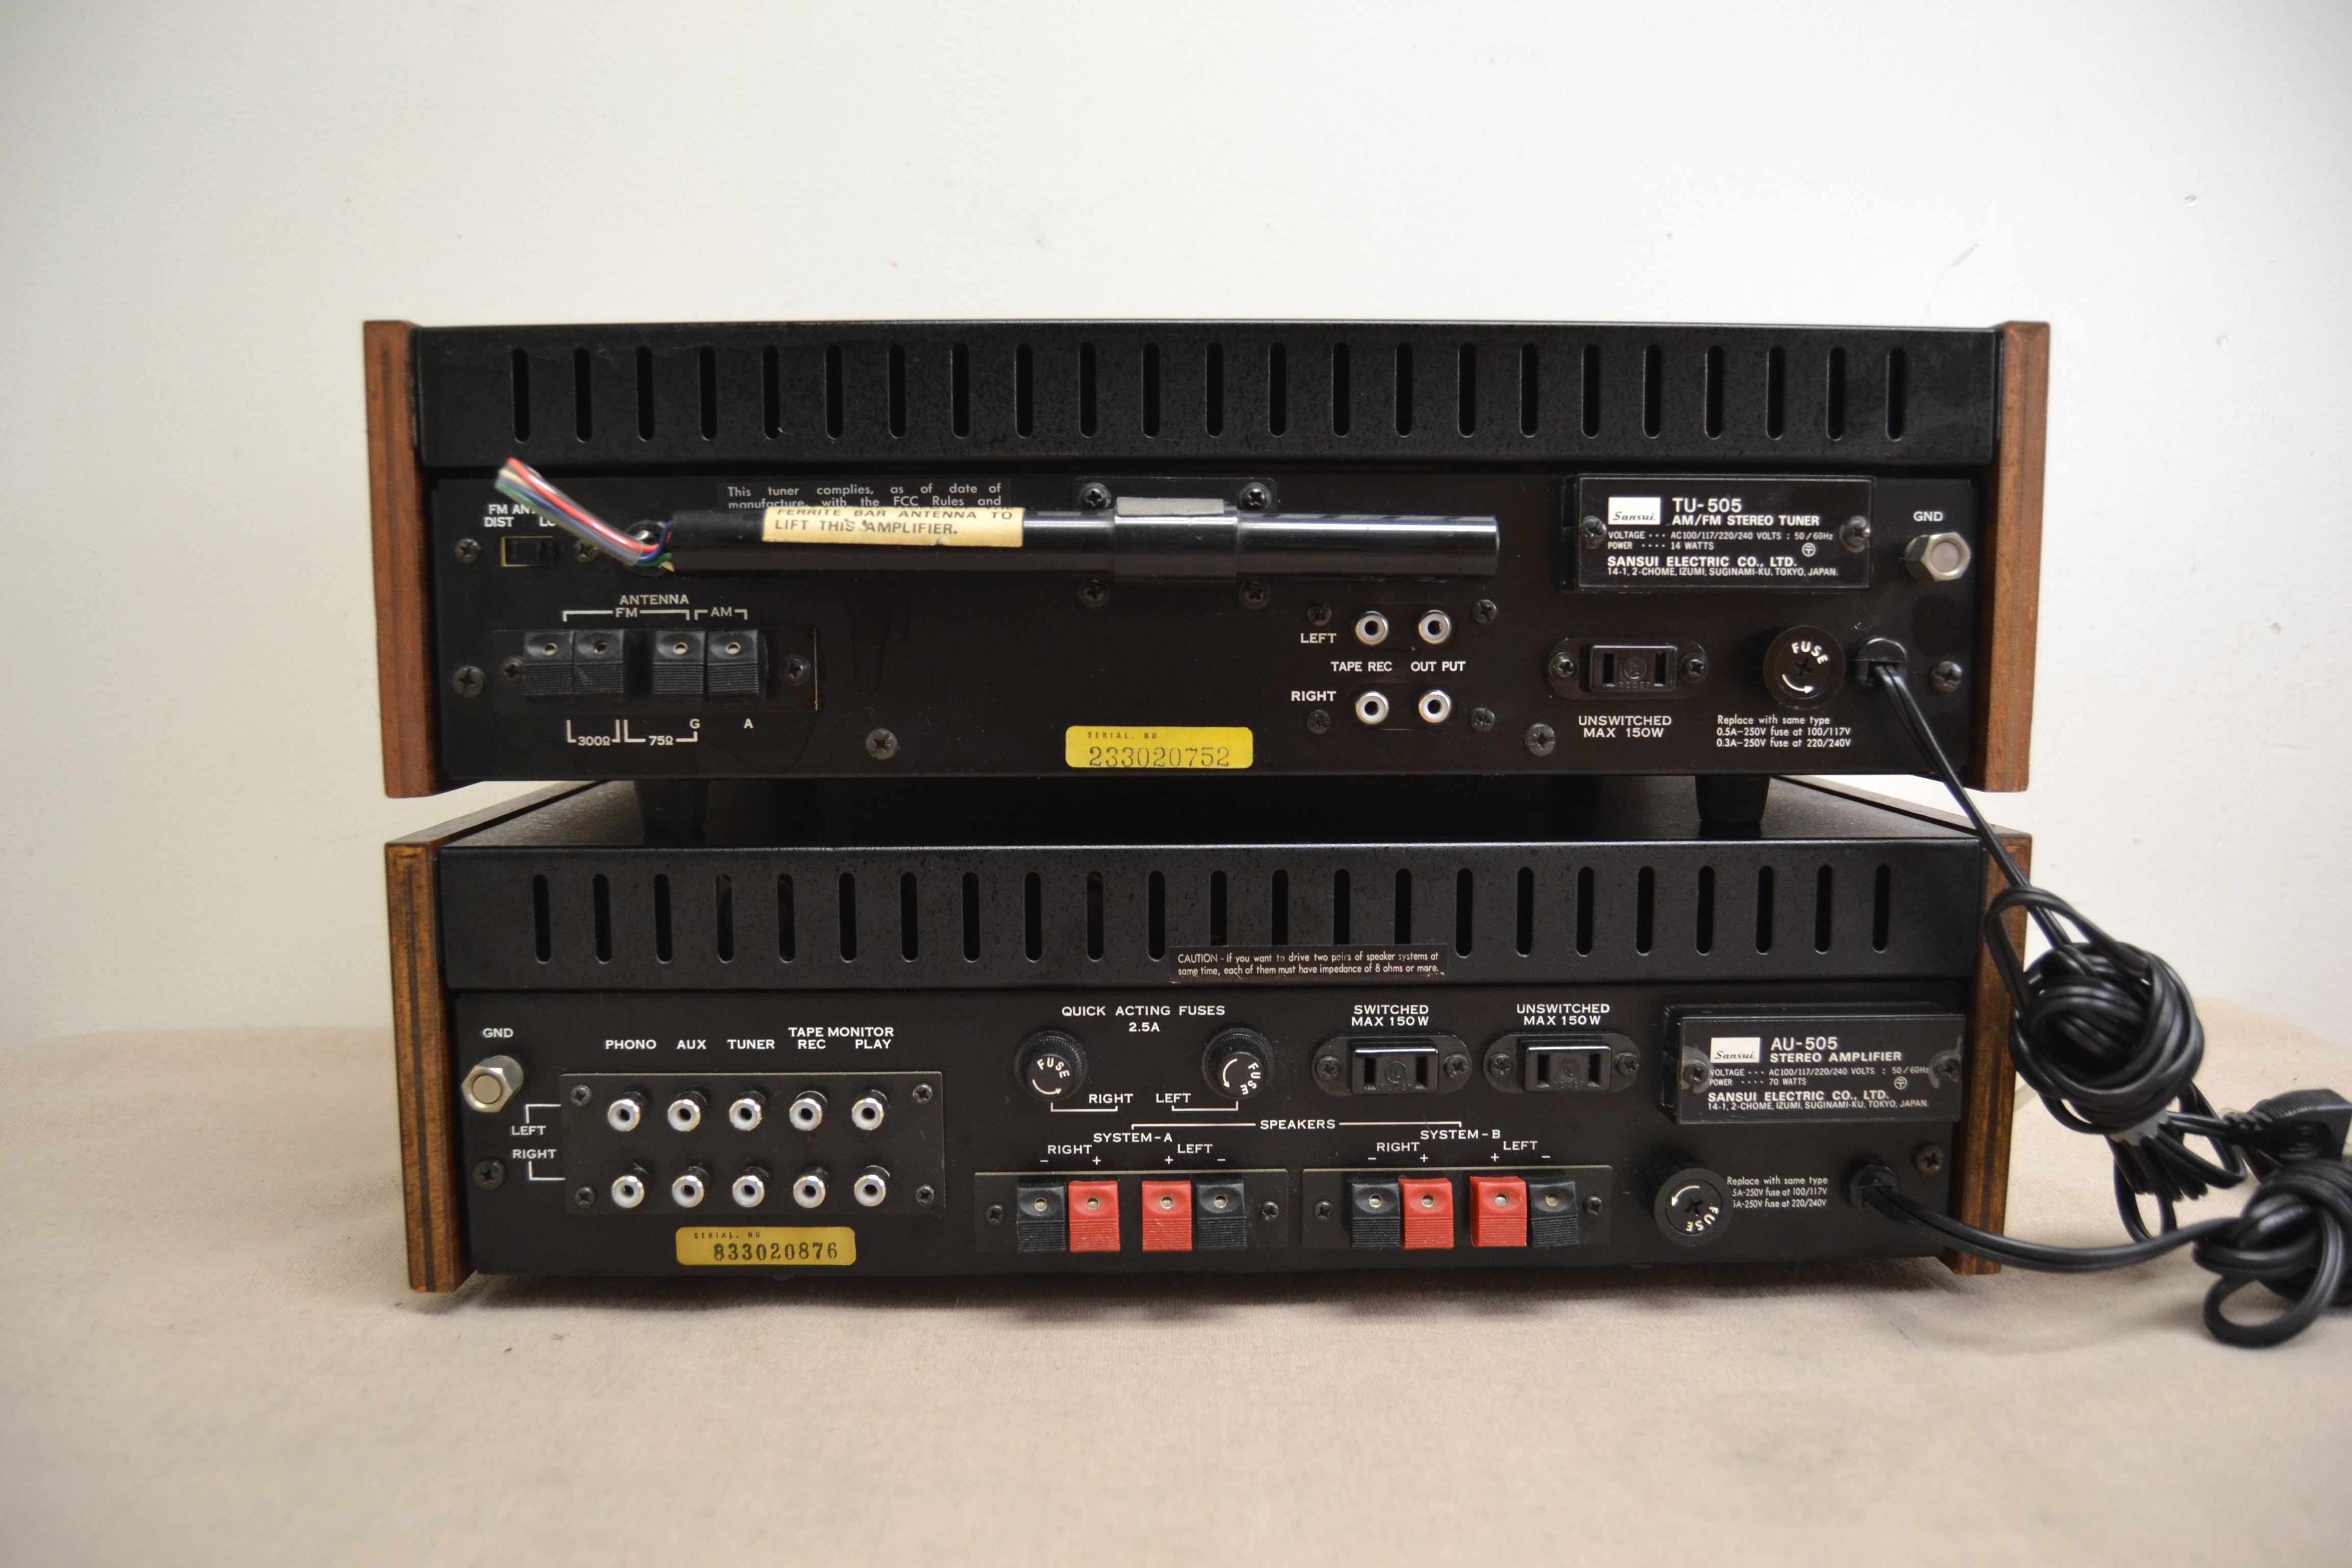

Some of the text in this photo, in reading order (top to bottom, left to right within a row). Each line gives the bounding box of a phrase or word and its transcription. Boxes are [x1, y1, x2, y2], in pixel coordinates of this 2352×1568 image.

[727, 486, 751, 497] This
[768, 486, 799, 496] tuner
[817, 484, 874, 496] complies,
[920, 482, 933, 494] of
[949, 483, 978, 494] date
[988, 482, 1001, 494] of
[821, 496, 1001, 507] with the FCC Rules and
[1672, 497, 1742, 513] TU-505
[488, 504, 508, 515] FM
[898, 510, 976, 519] ANTENNA
[483, 516, 514, 527] DIST
[1672, 513, 1820, 526] AM/FM STEREO TUNER
[1913, 511, 1944, 522] GND
[775, 519, 958, 535] LIFT THIS AMPLIFIER.
[1608, 530, 1782, 540] VOLTAGE VOLTS
[1607, 541, 1714, 550] POWER 14 WATTS
[1607, 555, 1659, 567] SANSUI
[1665, 556, 1729, 569] ELECTRIC
[1769, 556, 1797, 567] LTD.
[1679, 567, 1707, 577] IZUMI,
[1775, 567, 1807, 577] TOKYO,
[619, 594, 690, 605] ANTENNA
[616, 607, 732, 618] FM AM
[1300, 632, 1337, 644] LEFT
[1791, 641, 1829, 664] FUSE
[1330, 661, 1392, 672] TAPE REC
[1410, 660, 1466, 672] OUT PUT
[1291, 690, 1337, 702] RIGHT
[689, 718, 700, 729] G
[743, 718, 754, 729] A
[1578, 715, 1672, 726] UNSWITCHED
[1717, 715, 1831, 726] Replace with same type
[1087, 731, 1134, 740] SERIAL.
[1583, 727, 1664, 738] MAX 150W
[1770, 726, 1789, 736] fuse
[1793, 727, 1803, 736] at
[1807, 727, 1851, 736] 100/117V
[1770, 737, 1788, 747] fuse
[1792, 739, 1802, 747] at
[1806, 739, 1851, 747] 220/240V
[1089, 746, 1230, 767] 233020752
[1178, 950, 1439, 964] CAUTION you want to drive two pairs of speaker systems at
[1201, 966, 1220, 976] time,
[1224, 964, 1243, 975] each
[1245, 964, 1254, 974] of
[1257, 964, 1276, 974] them
[1278, 965, 1296, 974] must
[1298, 963, 1317, 974] have
[1320, 963, 1362, 974] impedance
[1364, 963, 1373, 973] of
[1375, 963, 1381, 973] 8
[1383, 962, 1403, 972] ohms
[1062, 1005, 1226, 1017] QUICK ACTING FUSES
[1353, 1004, 1429, 1015] SWITCHED
[1516, 1003, 1610, 1014] UNSWITCHED
[1352, 1016, 1384, 1026] MAX
[1524, 1015, 1556, 1025] MAX
[482, 1027, 514, 1038] GND
[788, 1026, 894, 1037] TAPE MONITOR
[1129, 1022, 1160, 1032] 2.5A
[605, 1039, 657, 1050] PHONO
[676, 1039, 707, 1050] AUX
[727, 1039, 775, 1050] TUNER
[797, 1039, 826, 1049] REC
[855, 1039, 892, 1049] PLAY
[1770, 1036, 1838, 1051] AU-505
[1770, 1051, 1902, 1063] STEREO AMPLIFIER
[1037, 1057, 1070, 1079] FUSE
[1710, 1067, 1875, 1076] VOLTAGE VOLTS
[1240, 1062, 1261, 1095] FUSE
[1709, 1077, 1807, 1086] POWER 70 WATTS
[1089, 1093, 1191, 1104] RIGHT LEFT
[1708, 1092, 1757, 1103] SANSUI
[1764, 1091, 1825, 1101] ELECTRIC
[1863, 1090, 1890, 1100] LTD.
[1776, 1101, 1803, 1110] IZUMI,
[1868, 1100, 1898, 1109] TOKYO,
[1260, 1119, 1336, 1130] SPEAKERS
[511, 1125, 547, 1136] LEFT
[1047, 1143, 1213, 1155] RIGHT LEFT
[1377, 1140, 1538, 1152] RIGHT LEFT
[512, 1148, 557, 1159] RIGHT
[1727, 1175, 1828, 1186] Replace with same type
[1766, 1187, 1827, 1196] fuse at 100/117V
[1765, 1198, 1827, 1208] fuse at 220/240V
[1685, 1206, 1719, 1232] FUSE
[694, 1232, 739, 1240] SERIAL.
[713, 1241, 838, 1262] 833020876
